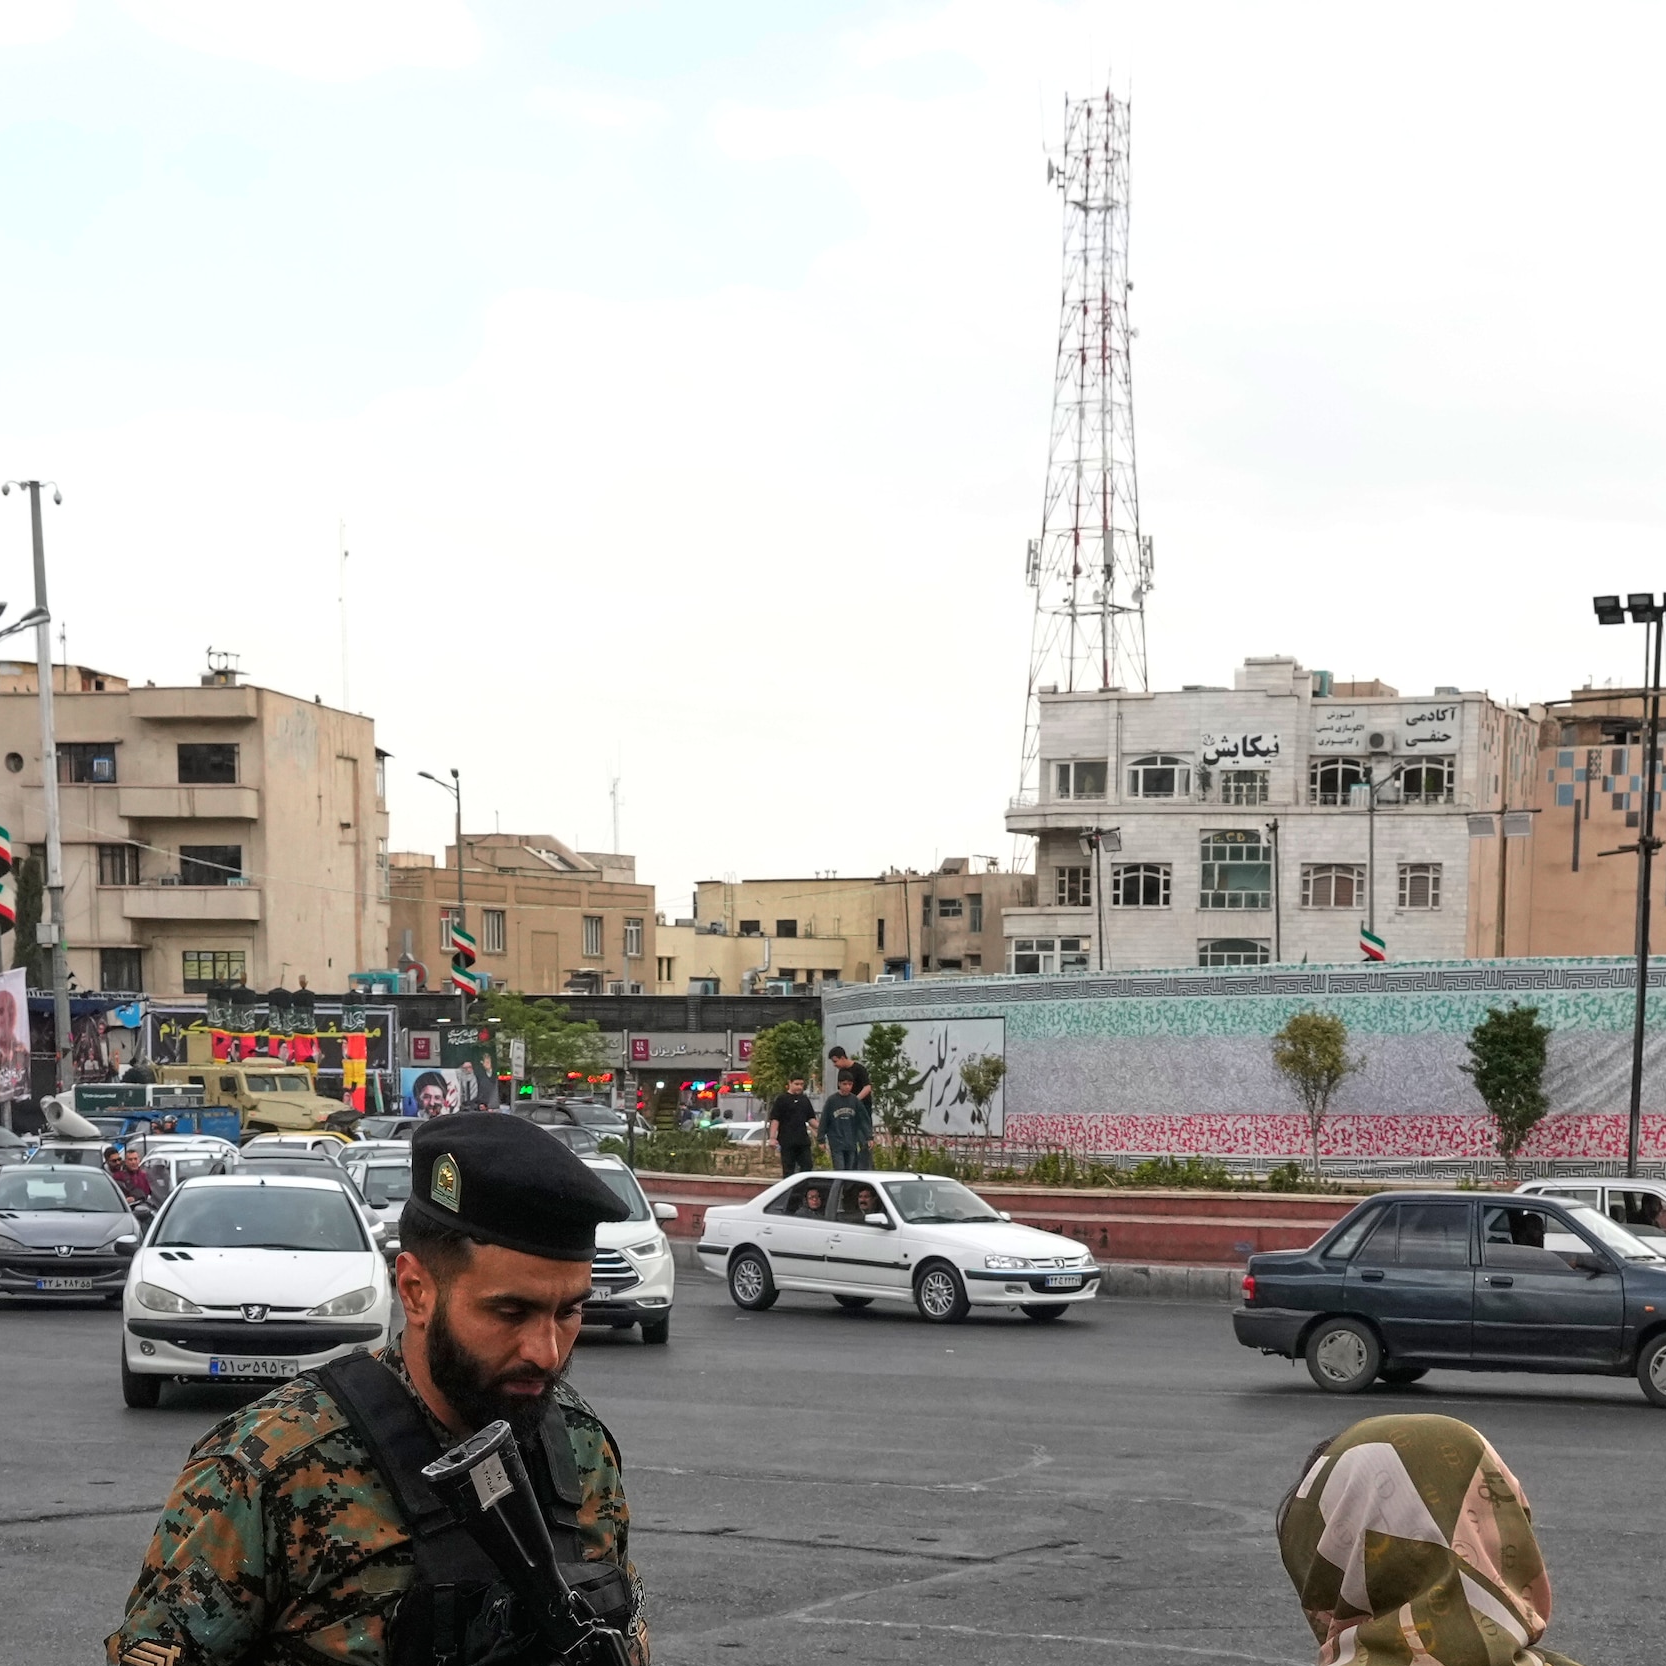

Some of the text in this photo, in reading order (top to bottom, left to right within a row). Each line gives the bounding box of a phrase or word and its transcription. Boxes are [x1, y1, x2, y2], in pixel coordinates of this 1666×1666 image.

[1405, 706, 1458, 726] آکادمی
[1405, 730, 1452, 747] حنفی
[1203, 734, 1279, 765] نیکایش
